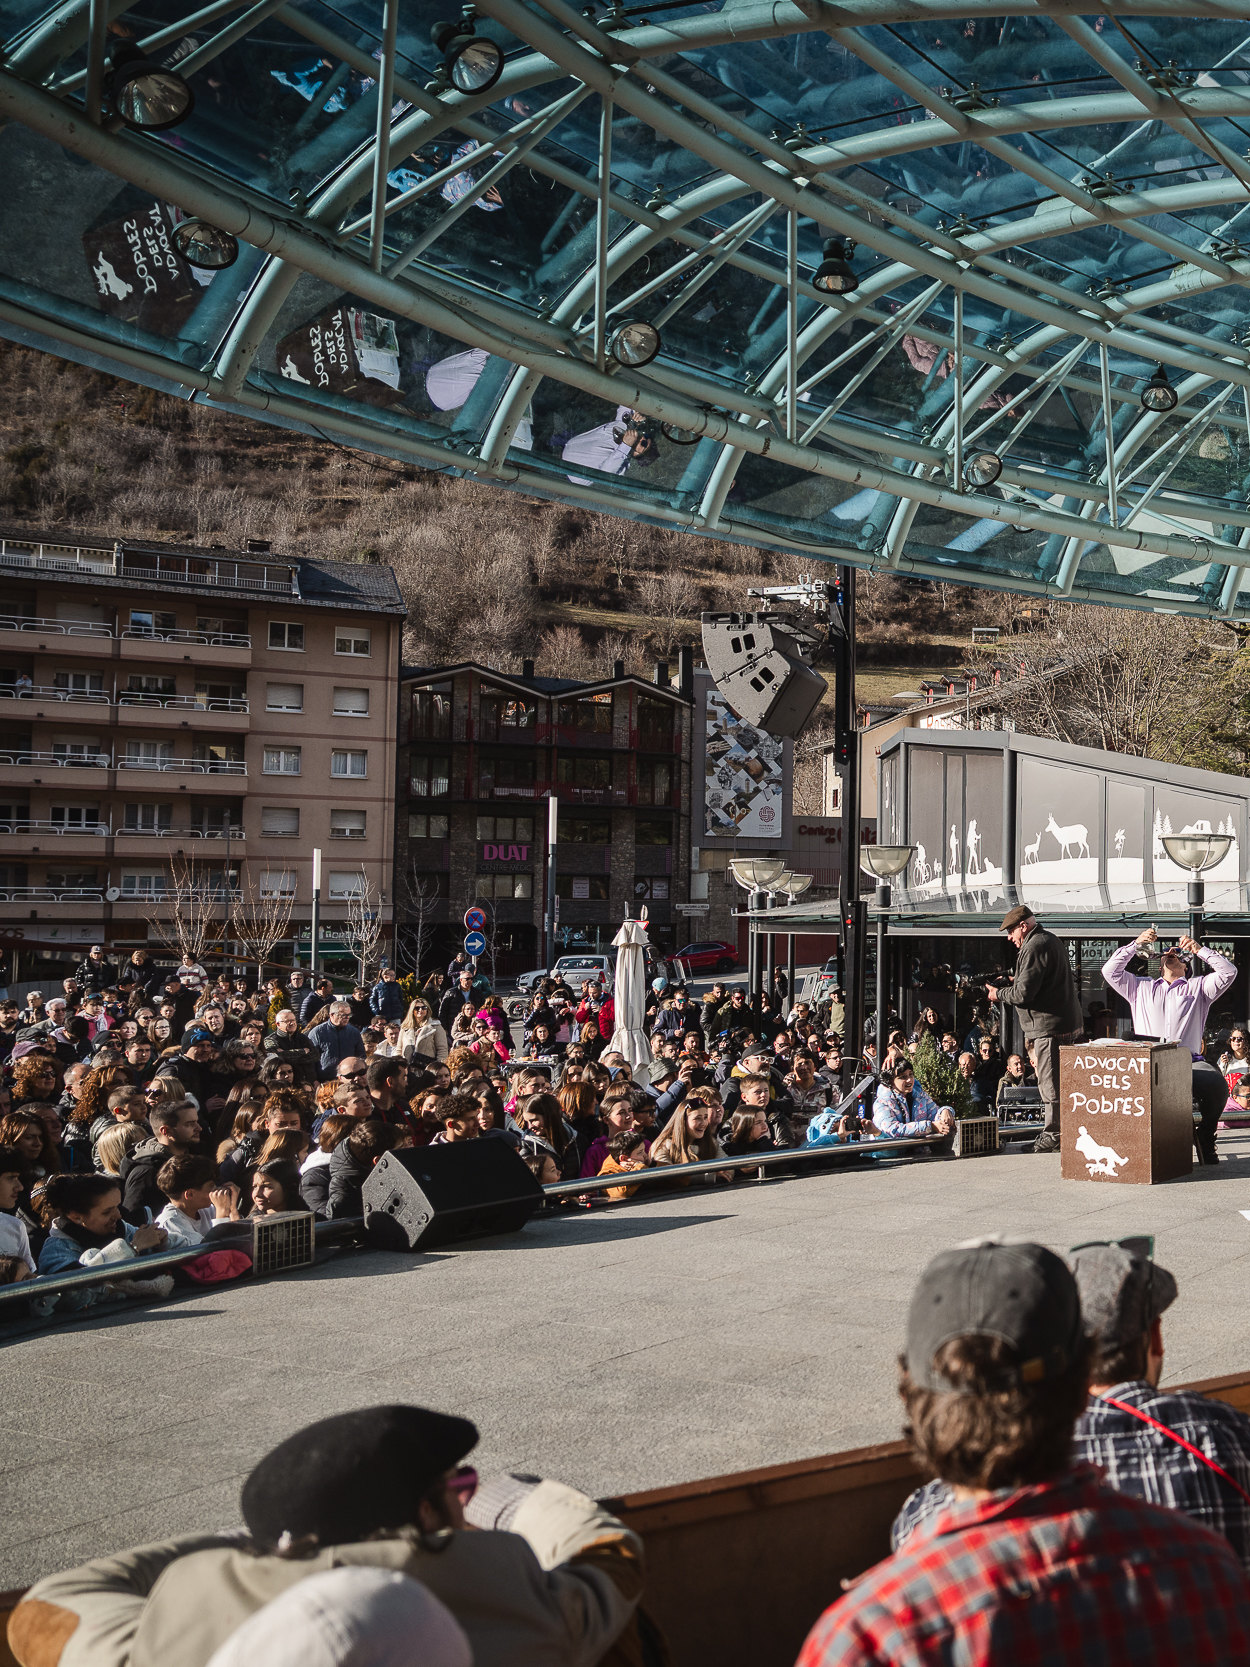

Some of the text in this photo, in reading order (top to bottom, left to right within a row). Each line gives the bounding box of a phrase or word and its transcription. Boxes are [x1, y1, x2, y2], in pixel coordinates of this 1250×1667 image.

[798, 824, 836, 836] Centre
[825, 835, 836, 844] de
[483, 844, 531, 861] DUAT
[1073, 1055, 1150, 1075] ADVOCAT
[1090, 1074, 1131, 1091] DELS
